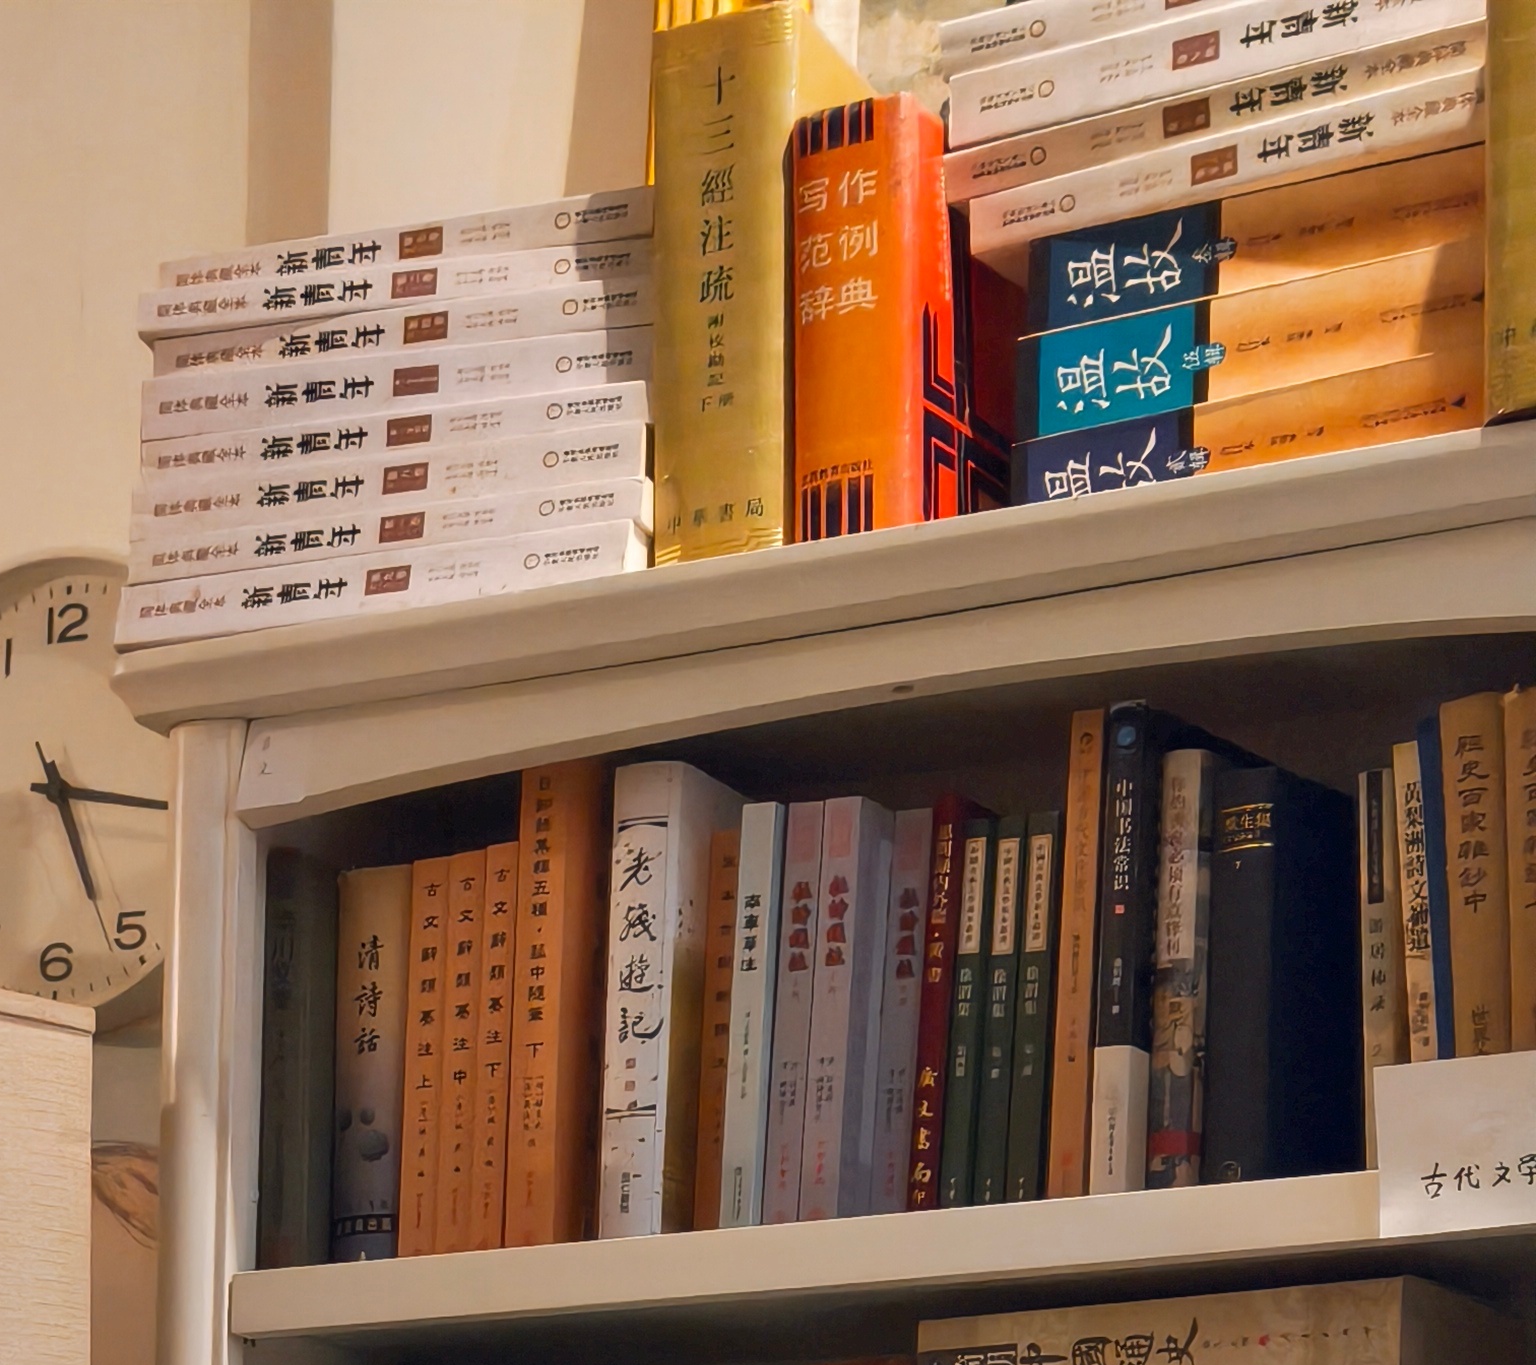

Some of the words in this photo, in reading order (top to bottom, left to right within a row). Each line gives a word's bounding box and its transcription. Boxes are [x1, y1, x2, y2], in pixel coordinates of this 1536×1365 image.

[1229, 63, 1348, 116] 新青年
[1257, 111, 1375, 163] 新青年
[699, 66, 735, 303] 十三經注疏
[798, 168, 878, 213] 写作
[276, 240, 382, 276] 新青年
[800, 220, 879, 274] 范例
[1066, 217, 1183, 308] 温故
[263, 278, 372, 310] 新青年
[800, 276, 879, 325] 辞典
[279, 324, 385, 359] 新青年
[1056, 323, 1172, 414] 温故
[264, 375, 374, 408] 新青年
[259, 427, 368, 460] 新青年
[256, 475, 364, 507] 新青年
[254, 523, 361, 557] 新青年
[241, 577, 348, 609] 新青年
[47, 603, 89, 645] 12
[1113, 779, 1133, 890] 中国书法常识
[114, 910, 147, 951] 5
[39, 942, 74, 982] 6
[353, 934, 384, 1055] 清詩話
